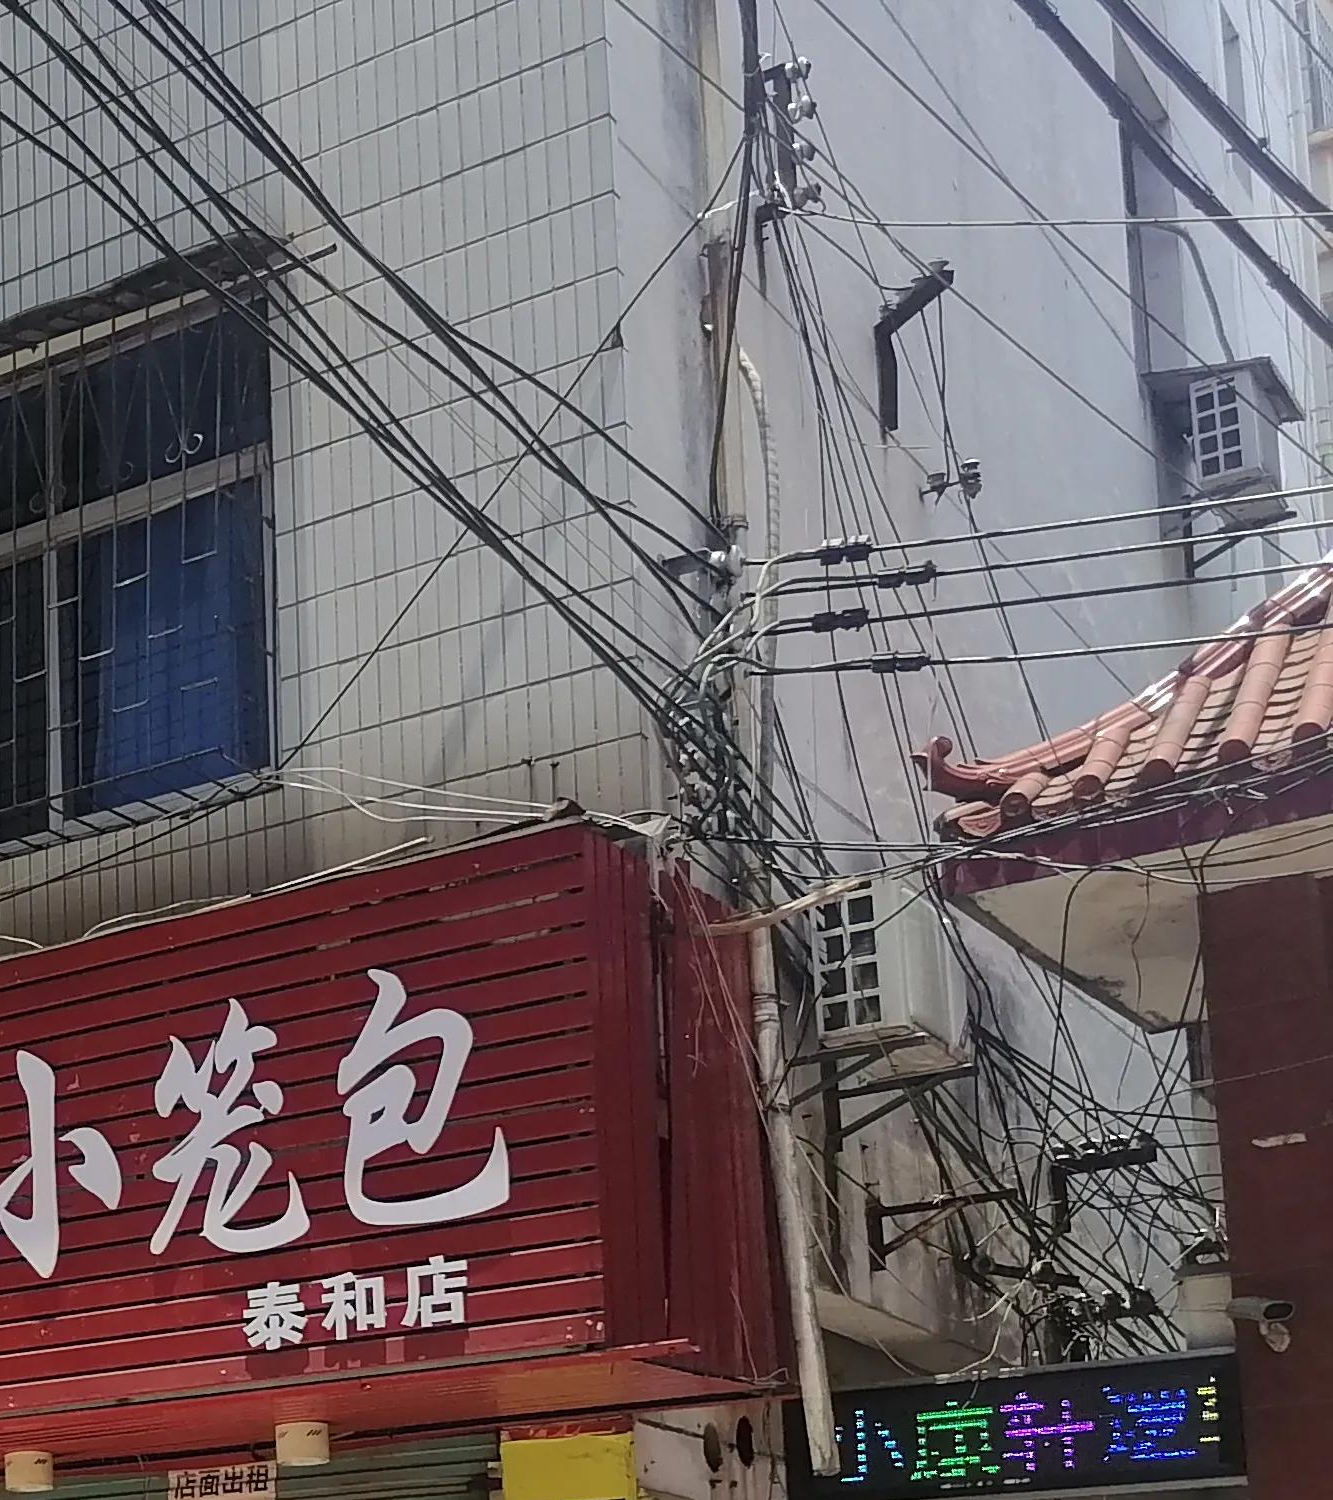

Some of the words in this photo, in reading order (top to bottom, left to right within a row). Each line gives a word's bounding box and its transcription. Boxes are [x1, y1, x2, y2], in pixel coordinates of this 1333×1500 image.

[243, 1255, 468, 1351] 泰和店
[174, 1465, 269, 1500] 店面出租
